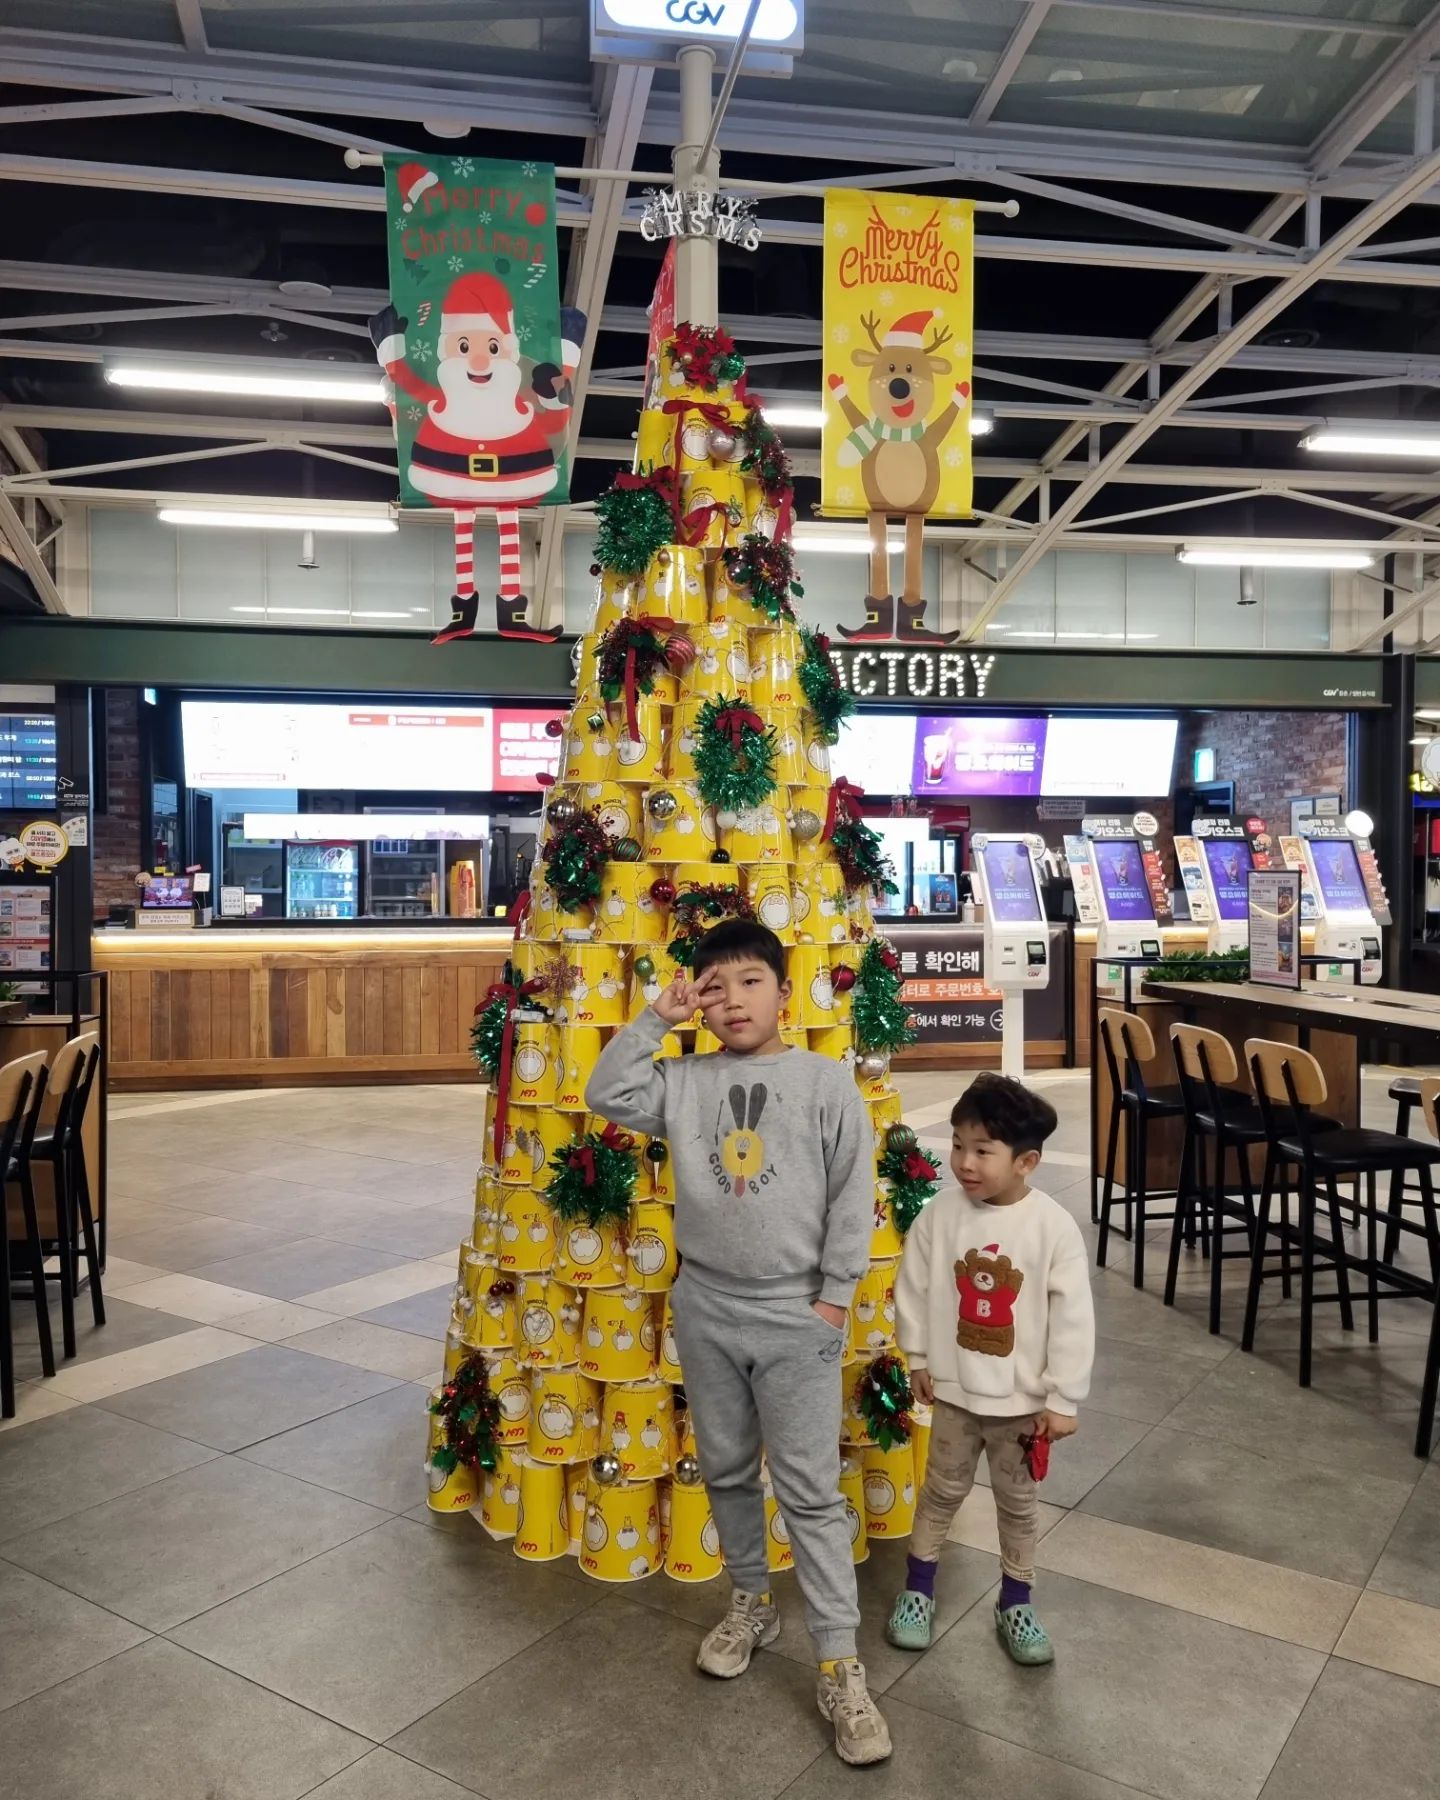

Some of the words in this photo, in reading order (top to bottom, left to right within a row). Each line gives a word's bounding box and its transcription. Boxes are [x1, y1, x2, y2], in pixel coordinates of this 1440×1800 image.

[666, 0, 726, 26] CGV
[421, 181, 525, 219] Merry
[402, 223, 545, 264] Christmas
[774, 693, 791, 702] CGV
[924, 950, 980, 973] 확인해
[935, 982, 985, 997] 주문번호
[940, 1014, 962, 1027] 확인
[965, 1014, 986, 1027] 가능
[520, 1089, 537, 1098] CGV
[561, 1095, 579, 1104] CGV
[504, 1169, 521, 1178] CGV
[709, 1152, 731, 1194] GOOD
[748, 1163, 778, 1195] BOY
[500, 1255, 516, 1264] CGV
[573, 1272, 592, 1280] CGV
[977, 1299, 992, 1318] B
[584, 1361, 599, 1372] CGV
[506, 1427, 525, 1437] CGV
[544, 1447, 564, 1456] CGV
[623, 1463, 635, 1472] CG
[453, 1493, 471, 1504] CGV
[867, 1521, 887, 1532] CGV
[521, 1541, 537, 1552] CGV
[584, 1557, 598, 1569] CGV
[674, 1561, 692, 1573] CGV
